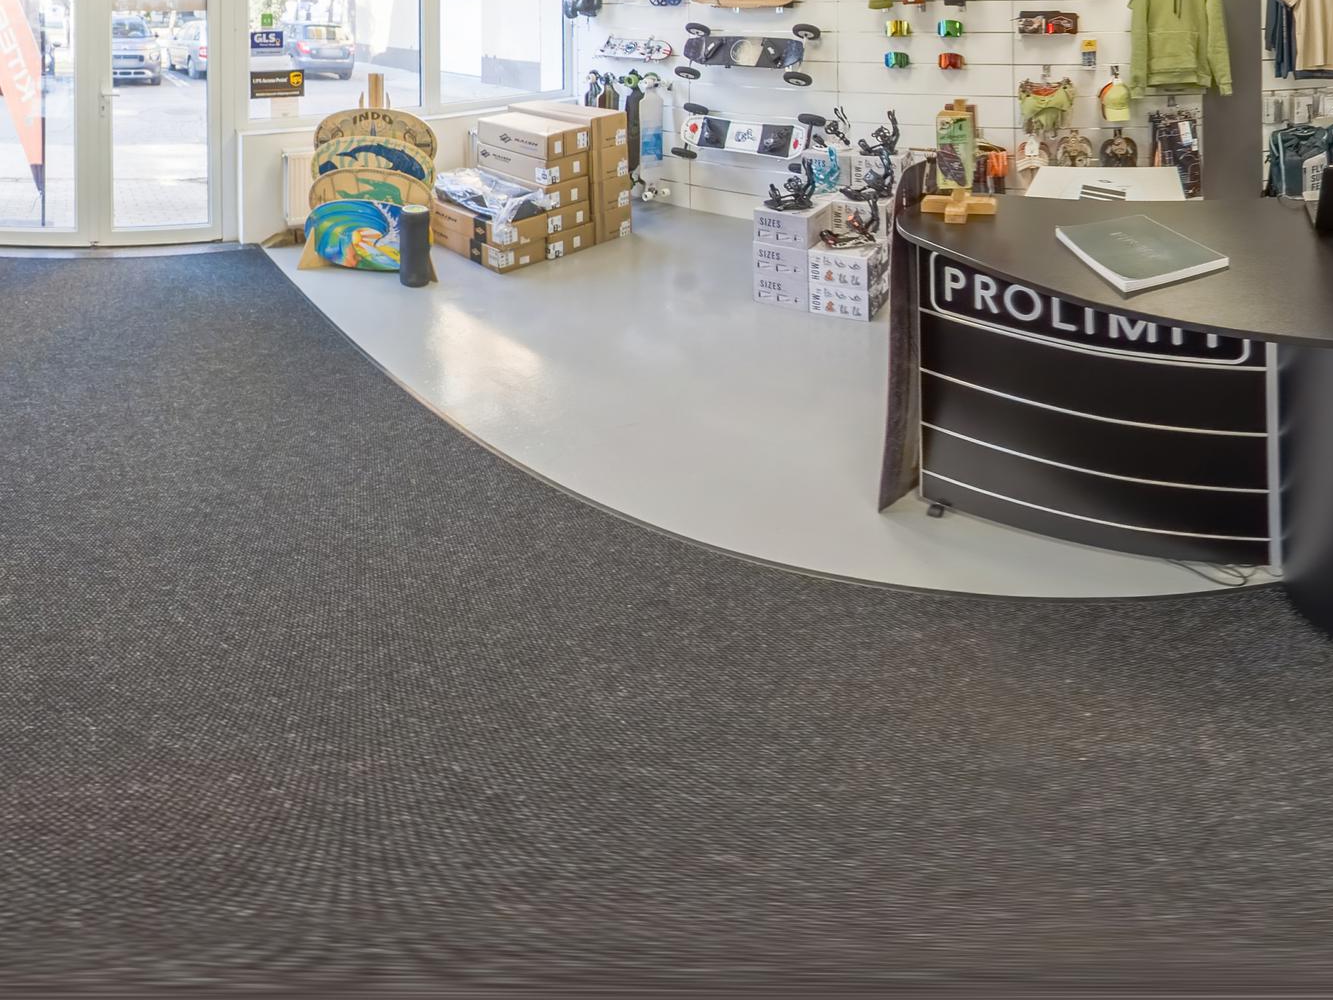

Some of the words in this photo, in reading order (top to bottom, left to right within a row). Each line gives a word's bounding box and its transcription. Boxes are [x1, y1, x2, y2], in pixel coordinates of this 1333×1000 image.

[254, 33, 276, 43] GLS
[353, 112, 393, 125] INDO
[854, 166, 862, 183] HOW
[759, 216, 782, 229] SIZES
[834, 211, 842, 229] HOW
[758, 249, 781, 261] SIZES
[811, 261, 819, 280] HOW
[759, 279, 782, 291] SIZES
[812, 292, 820, 310] HOW
